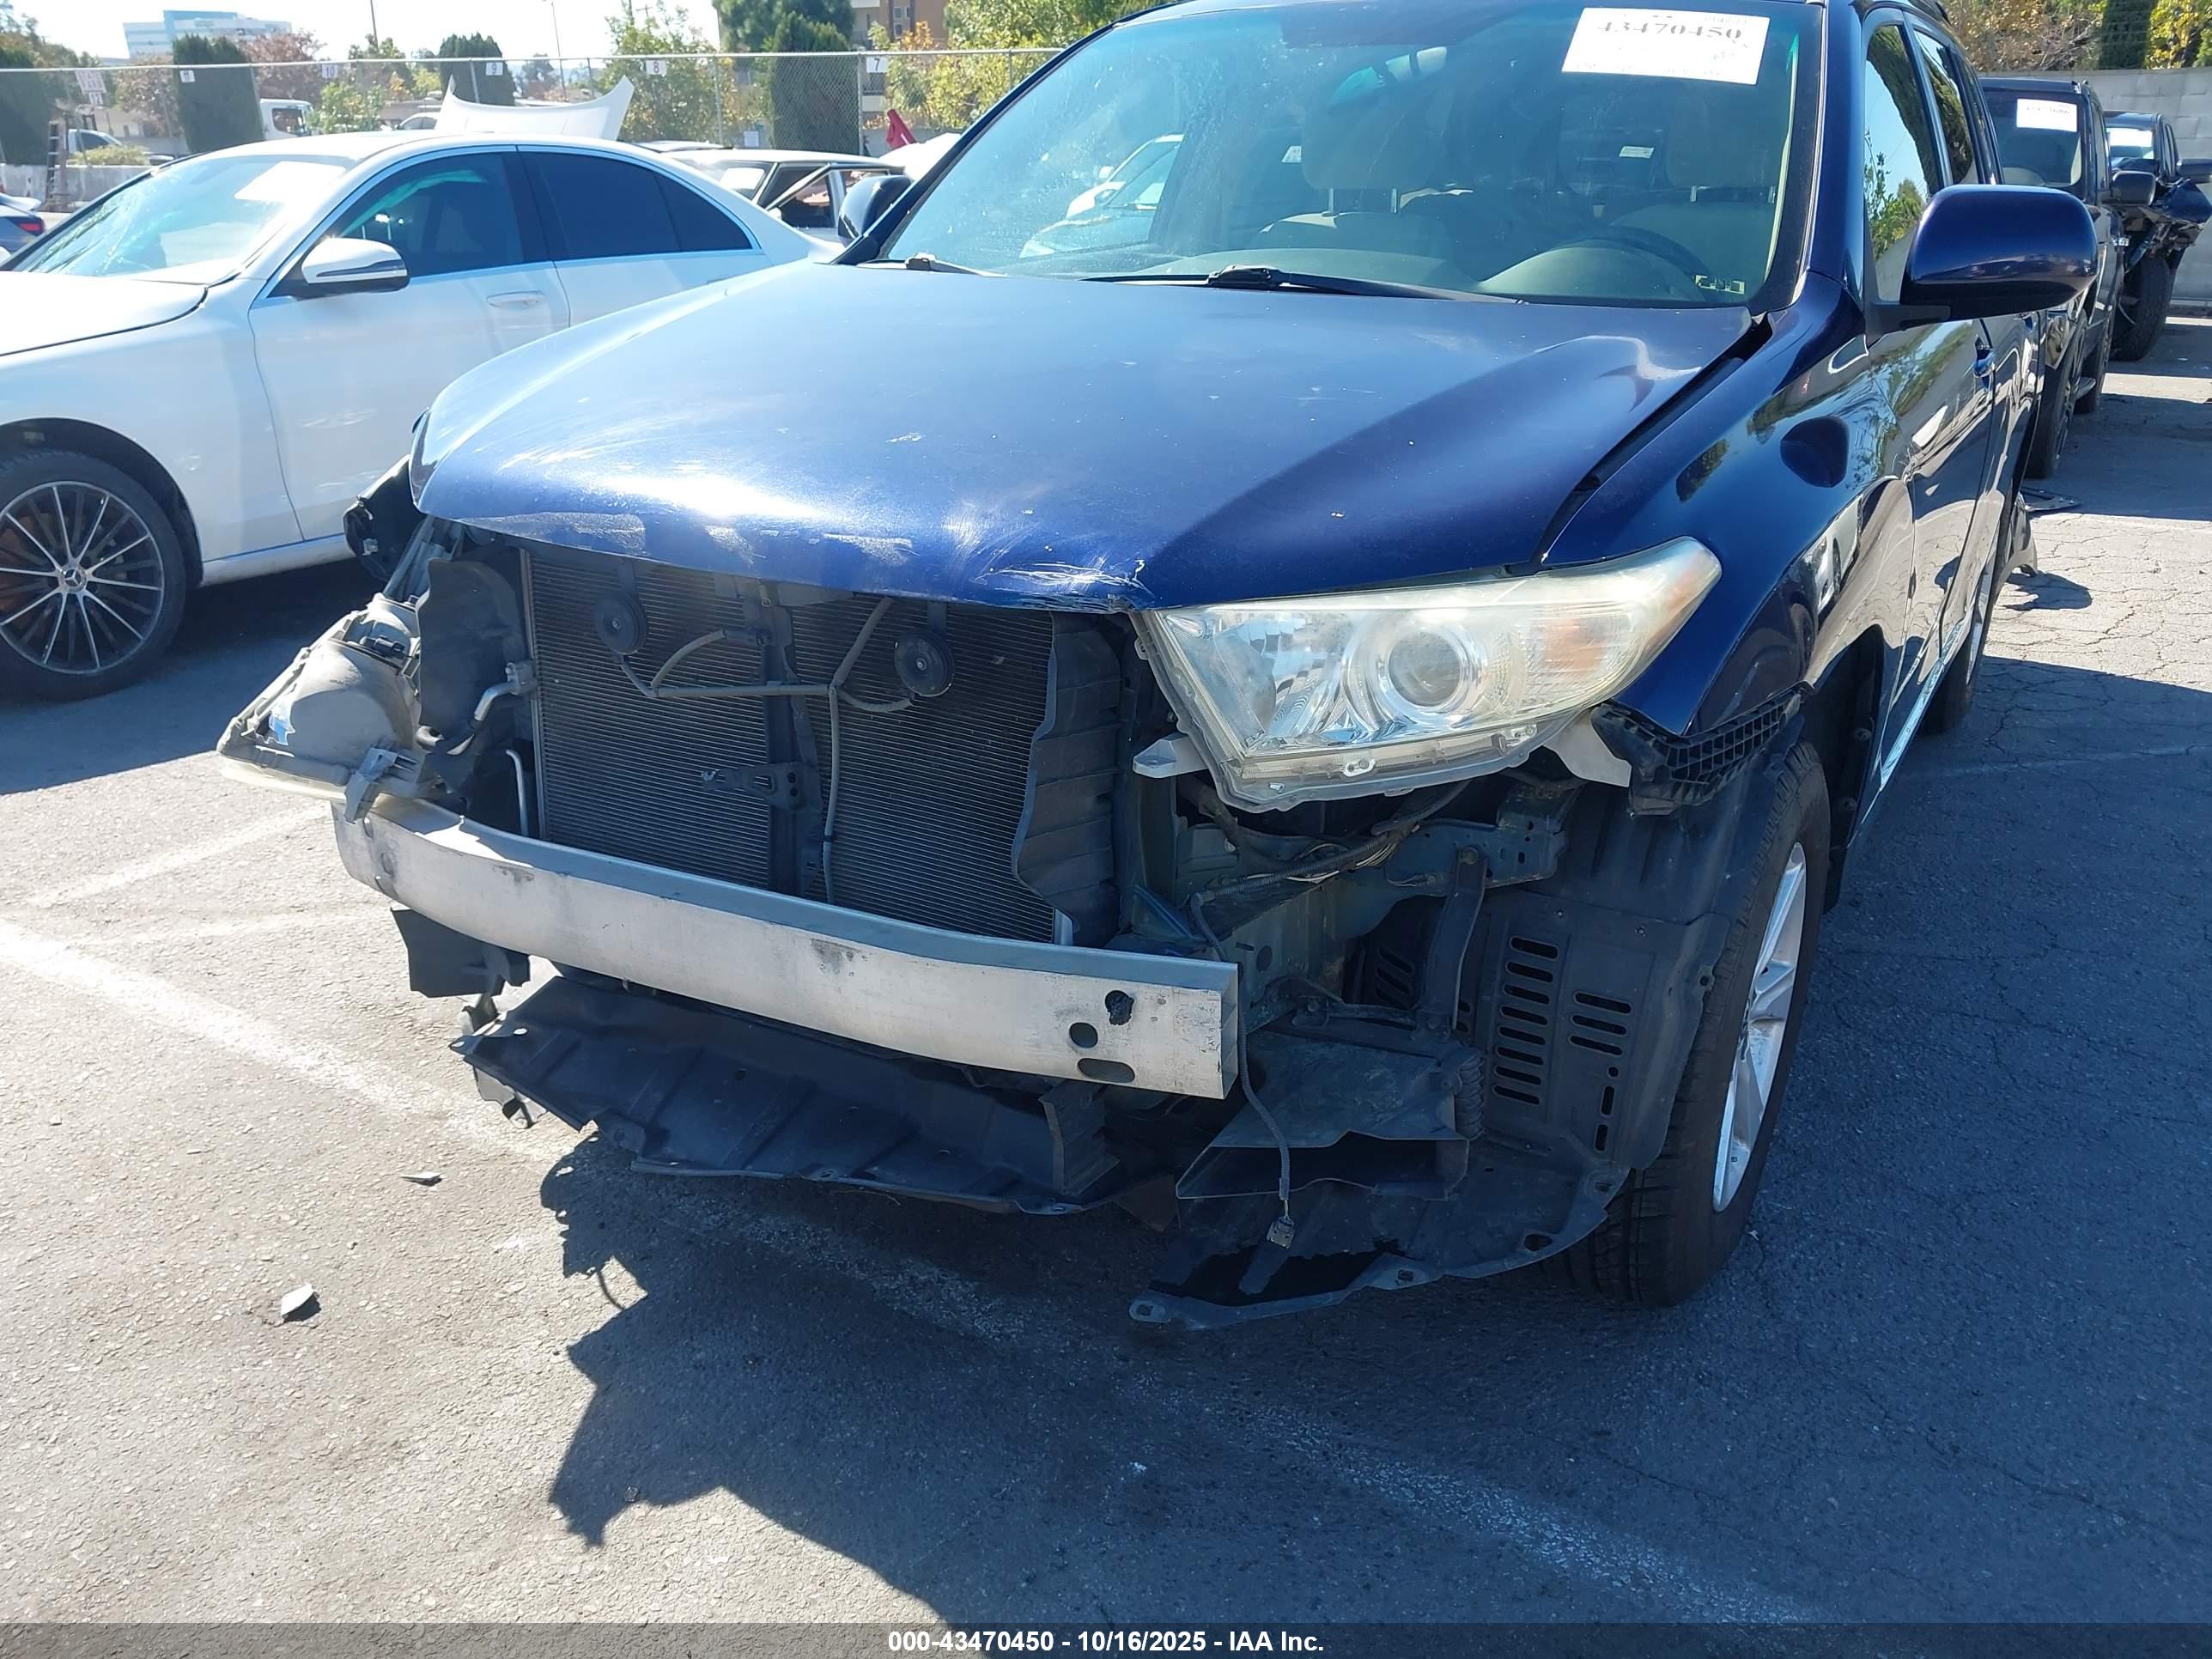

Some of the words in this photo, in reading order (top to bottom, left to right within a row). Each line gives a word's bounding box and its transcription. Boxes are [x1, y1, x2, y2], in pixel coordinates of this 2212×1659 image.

[491, 63, 498, 75] 9
[653, 61, 660, 74] 8
[873, 58, 881, 71] 7
[325, 66, 336, 77] 10
